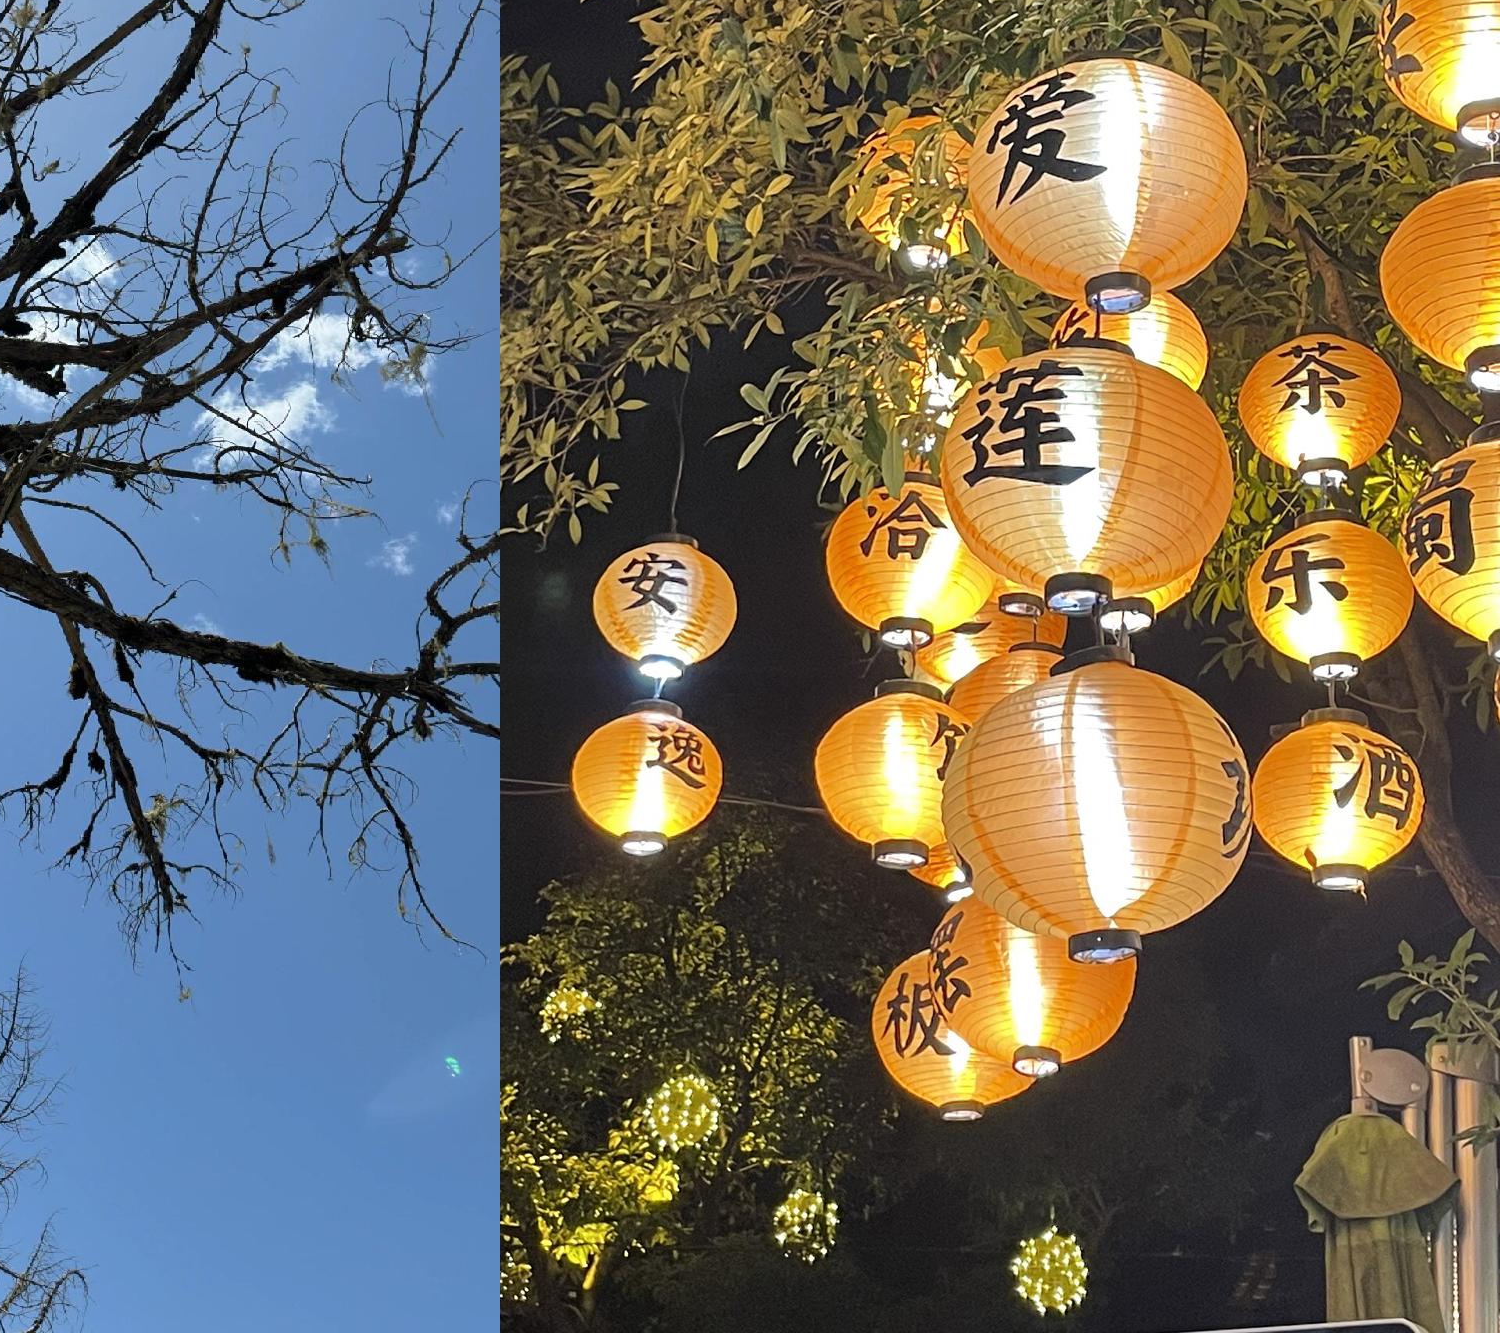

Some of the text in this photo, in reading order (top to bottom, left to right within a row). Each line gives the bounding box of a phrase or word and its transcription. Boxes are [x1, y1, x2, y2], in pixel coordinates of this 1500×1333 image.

[987, 71, 1108, 210] 爱
[1271, 340, 1361, 416] 茶
[961, 359, 1096, 488] 莲
[1405, 459, 1476, 576] 蜀
[618, 552, 689, 615] 安
[1261, 534, 1349, 615] 乐
[645, 721, 706, 790] 逸
[1332, 733, 1416, 831] 酒
[882, 972, 957, 1059] 板
